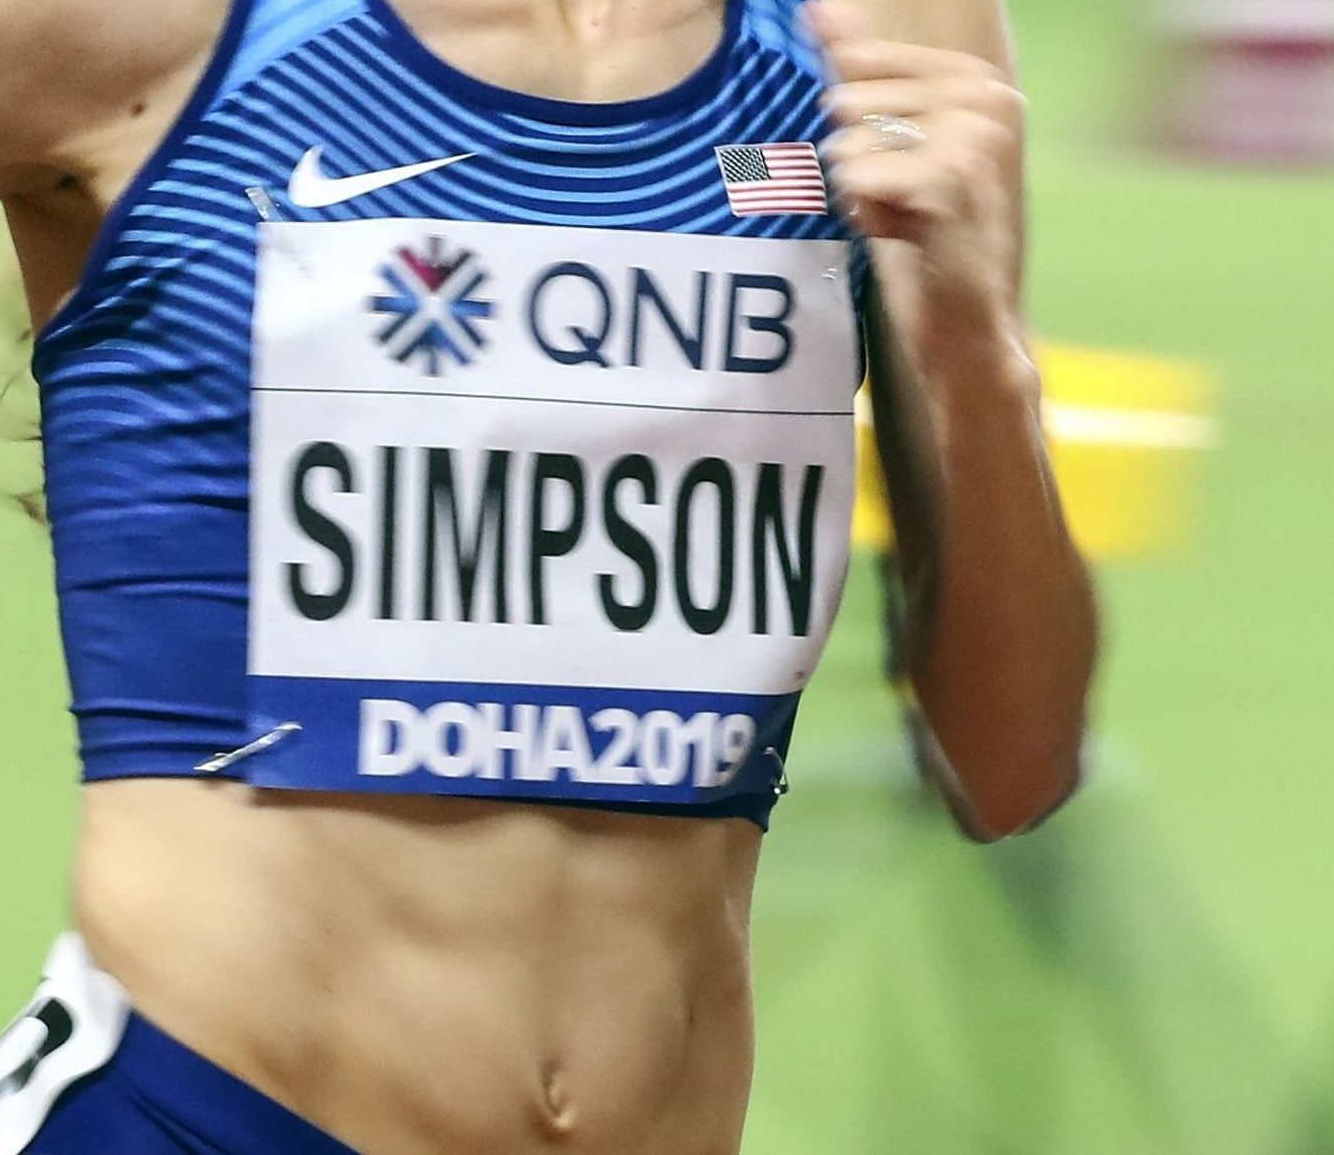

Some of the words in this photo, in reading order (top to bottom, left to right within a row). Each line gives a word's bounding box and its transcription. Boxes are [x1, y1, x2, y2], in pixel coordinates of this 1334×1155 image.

[525, 259, 796, 375] QNB
[282, 440, 825, 637] SIMPSON
[358, 697, 756, 787] DOHA2019
